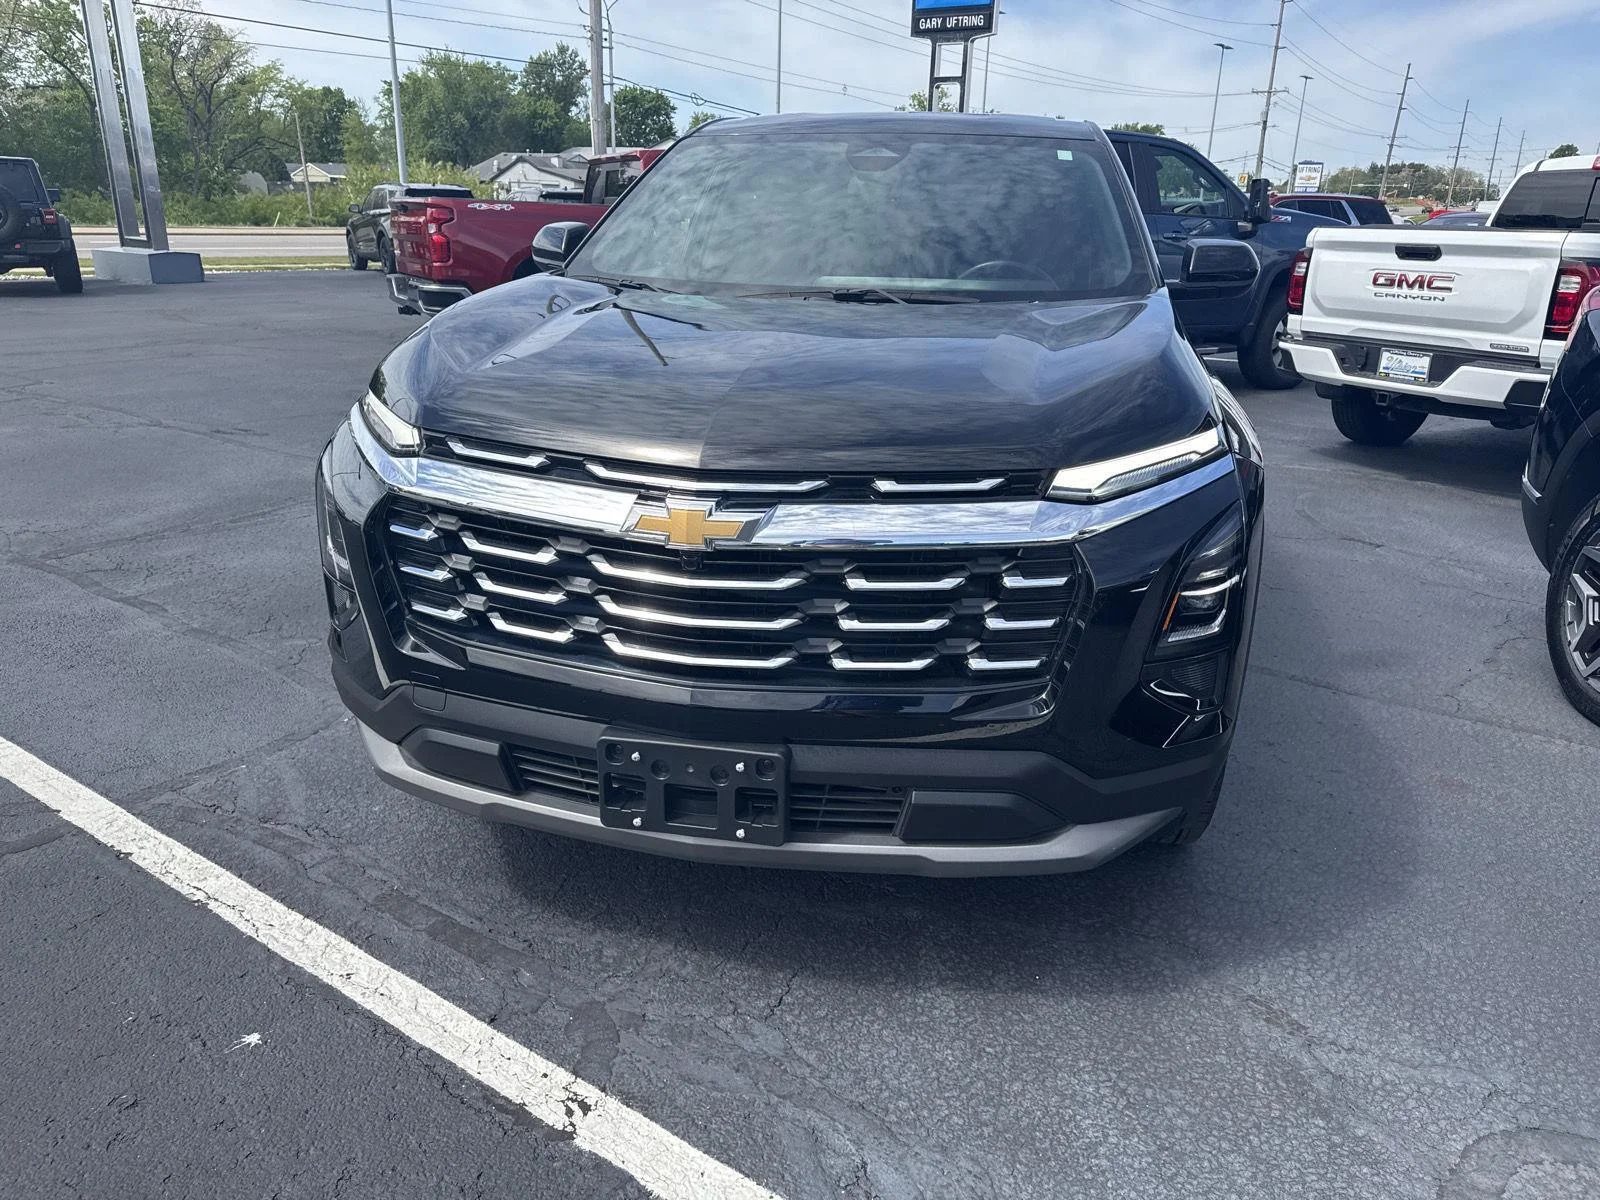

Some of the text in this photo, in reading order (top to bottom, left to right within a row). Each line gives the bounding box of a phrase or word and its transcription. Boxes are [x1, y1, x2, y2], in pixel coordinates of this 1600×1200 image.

[919, 15, 984, 30] GARY UFTRING
[1372, 272, 1456, 293] GMC
[1374, 292, 1445, 302] CANYON
